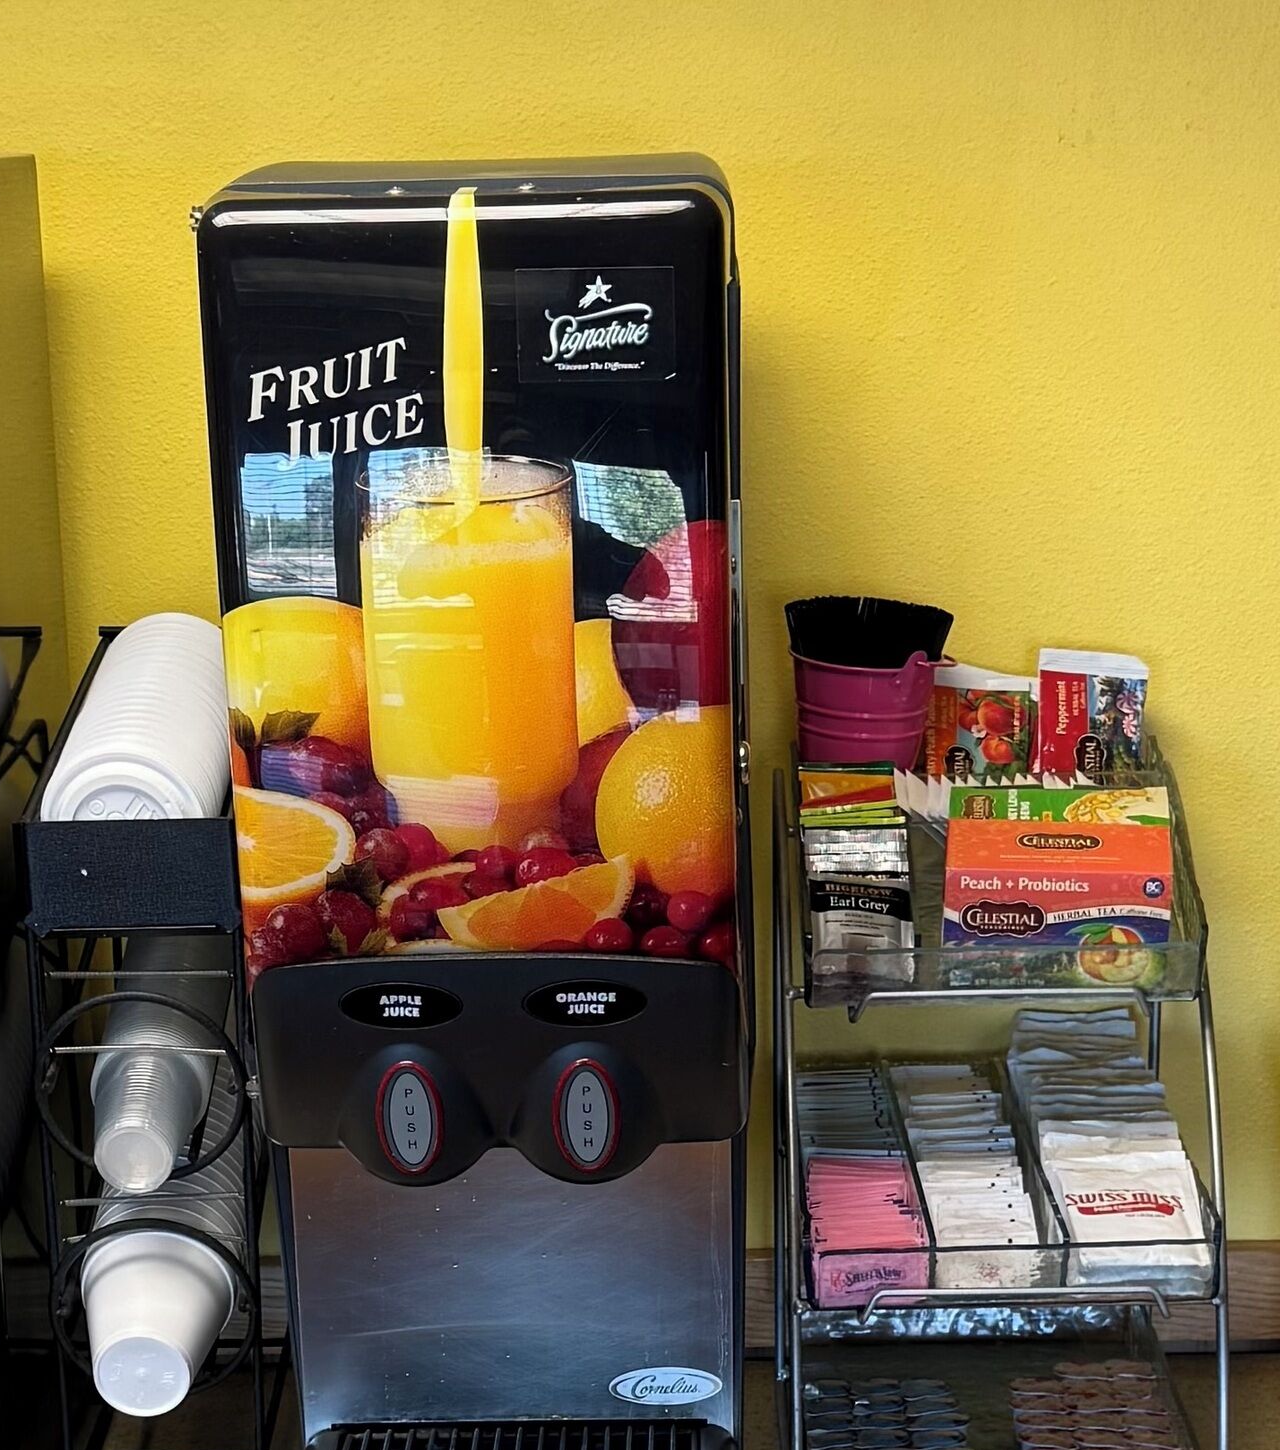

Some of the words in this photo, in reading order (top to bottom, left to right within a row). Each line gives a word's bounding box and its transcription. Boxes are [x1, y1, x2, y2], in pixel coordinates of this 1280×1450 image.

[542, 304, 652, 362] Signature
[247, 337, 408, 422] FRUIT
[286, 393, 426, 463] JUICE
[1055, 680, 1074, 735] Peppermint
[953, 752, 965, 774] STIAL
[1020, 801, 1030, 820] SENG
[1023, 836, 1095, 847] CELESTIAL
[825, 883, 894, 896] BIGELOW
[960, 875, 1001, 890] Peach
[1006, 880, 1014, 889] +
[1019, 877, 1090, 892] Probiotics
[830, 896, 855, 907] Earl
[858, 898, 890, 914] Grey
[967, 909, 1039, 926] CELESTIAL
[1053, 909, 1093, 922] HERBAL
[1097, 907, 1117, 916] TEA
[379, 995, 423, 1006] APPLE
[555, 992, 617, 1003] ORANGE
[382, 1006, 421, 1018] JUICE
[567, 1003, 606, 1015] JUICE
[404, 1088, 418, 1149] PUSH
[582, 1086, 594, 1147] PUSH
[631, 1374, 699, 1399] Cornelius
